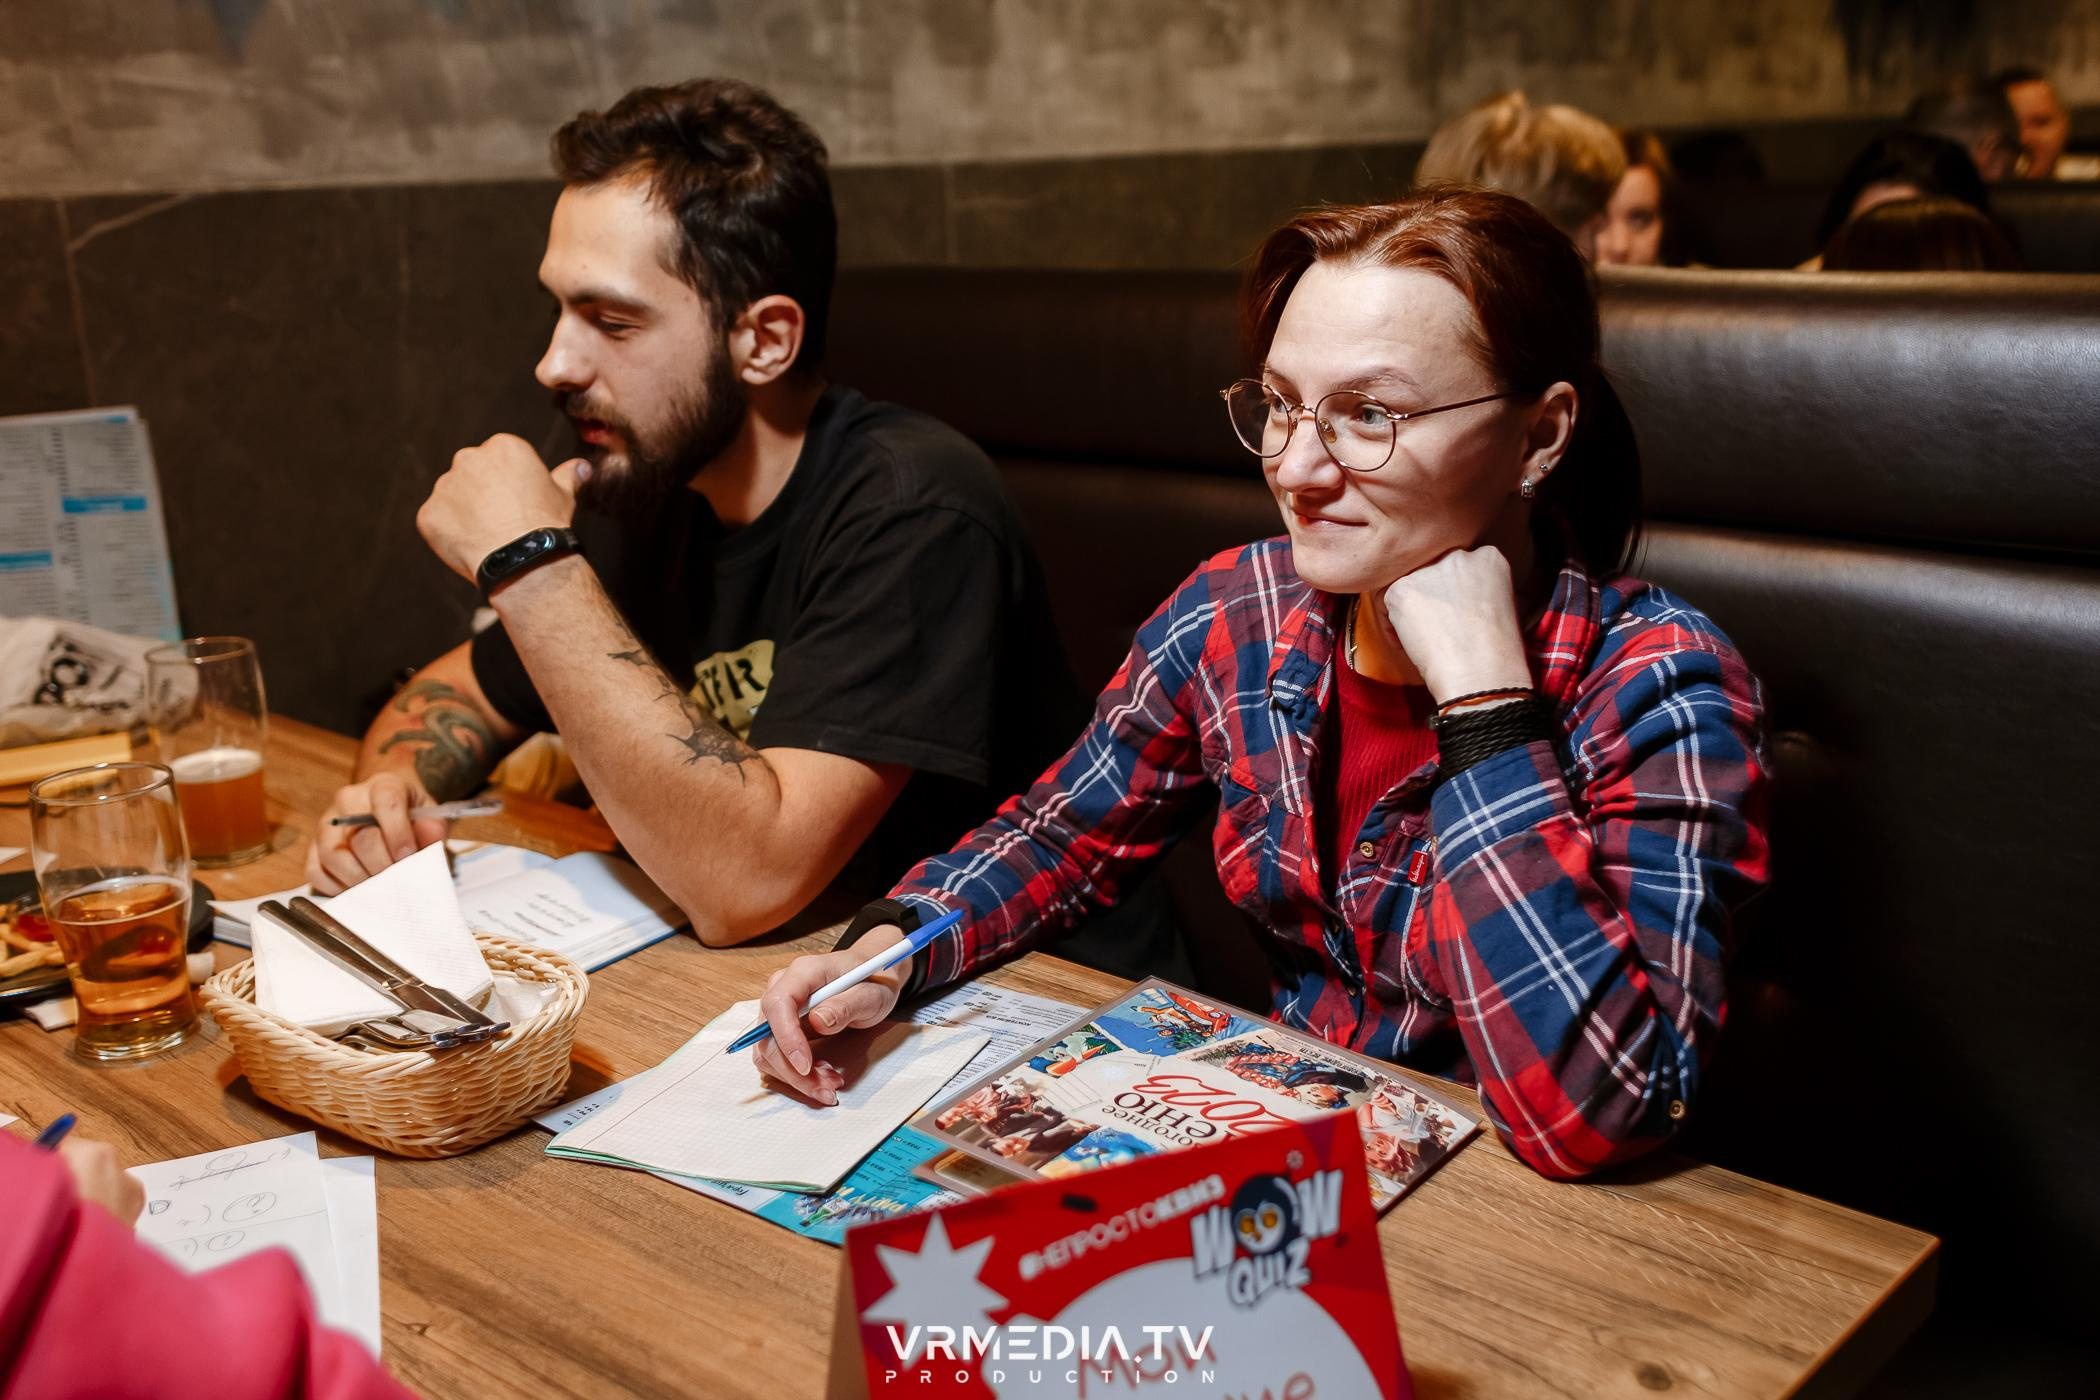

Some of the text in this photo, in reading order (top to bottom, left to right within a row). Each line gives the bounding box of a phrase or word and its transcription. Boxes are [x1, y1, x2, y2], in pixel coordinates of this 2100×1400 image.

[1101, 1104, 1204, 1150] огоднее
[1113, 1092, 1237, 1144] еню
[1228, 1237, 1312, 1308] QUIZ
